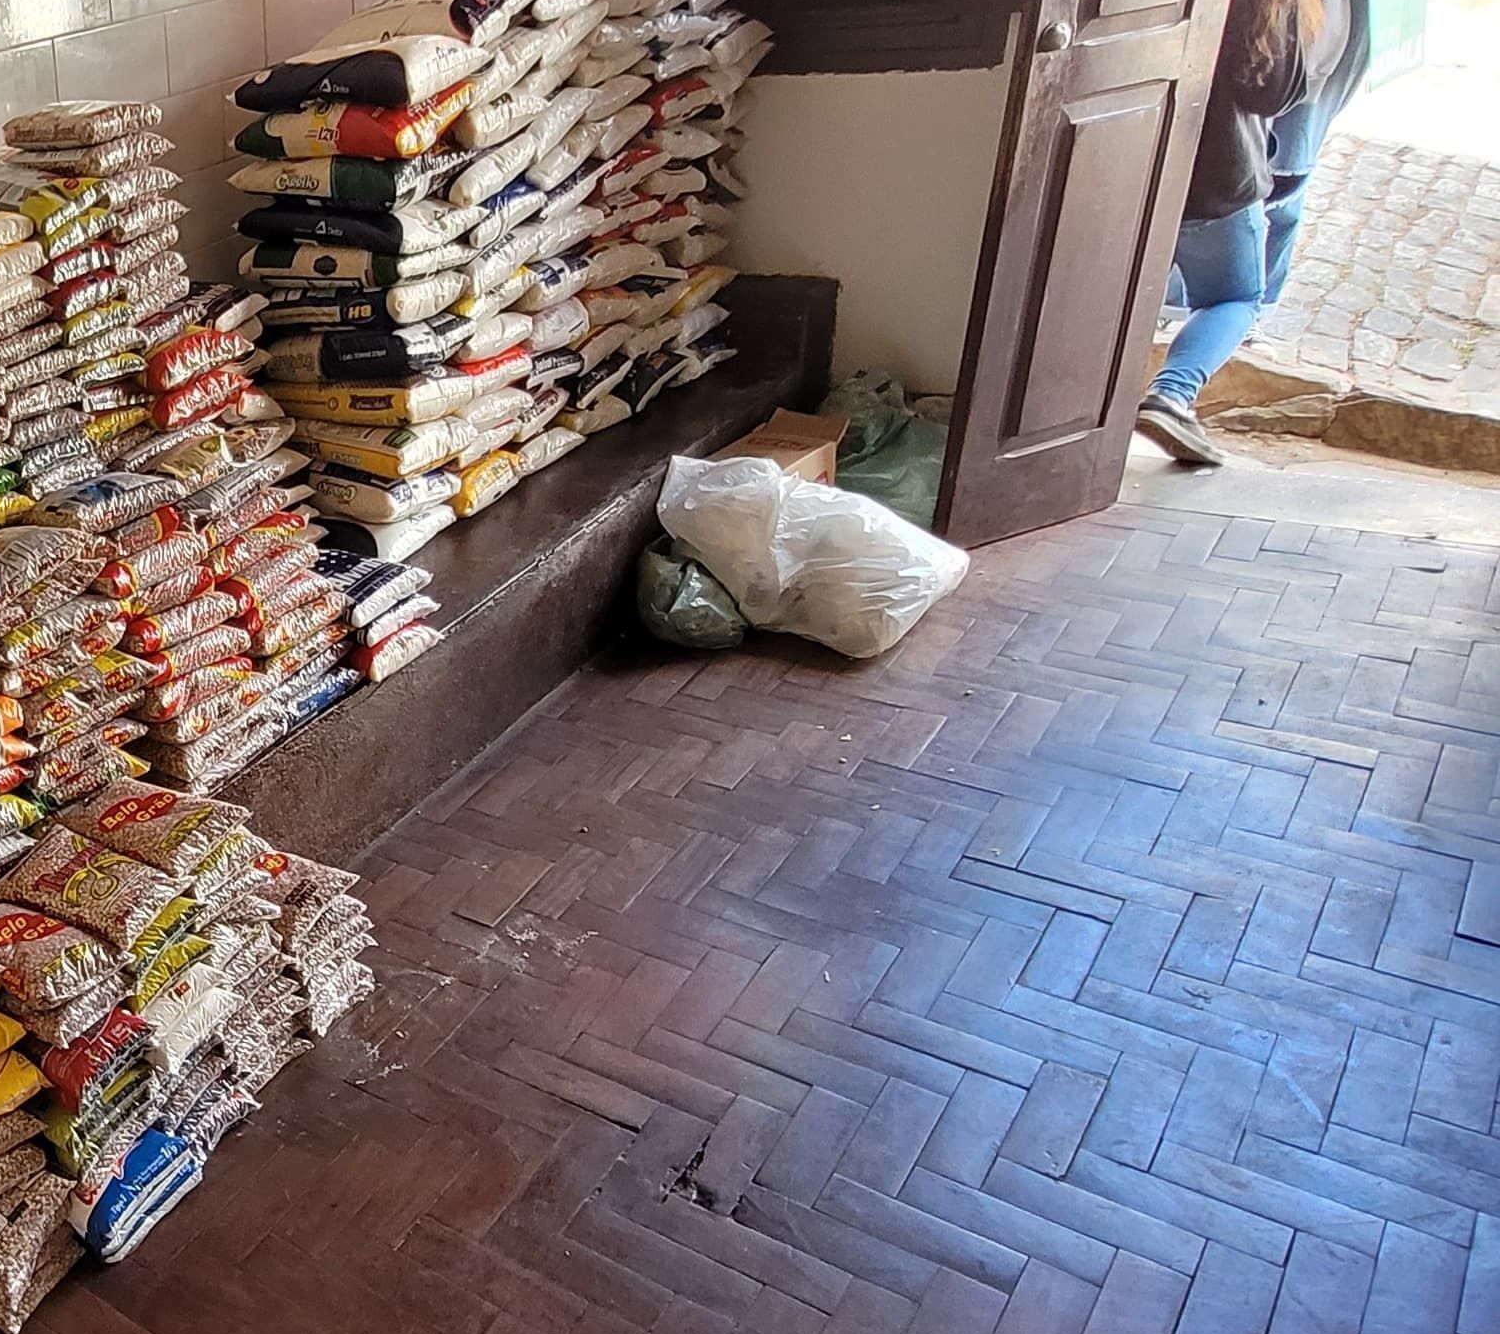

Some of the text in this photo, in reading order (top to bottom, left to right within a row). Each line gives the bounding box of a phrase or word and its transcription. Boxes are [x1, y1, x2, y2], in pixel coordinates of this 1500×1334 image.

[349, 305, 372, 319] BH
[332, 557, 383, 592] Alvinh
[102, 792, 174, 830] Belo Grão
[21, 918, 59, 941] Grã
